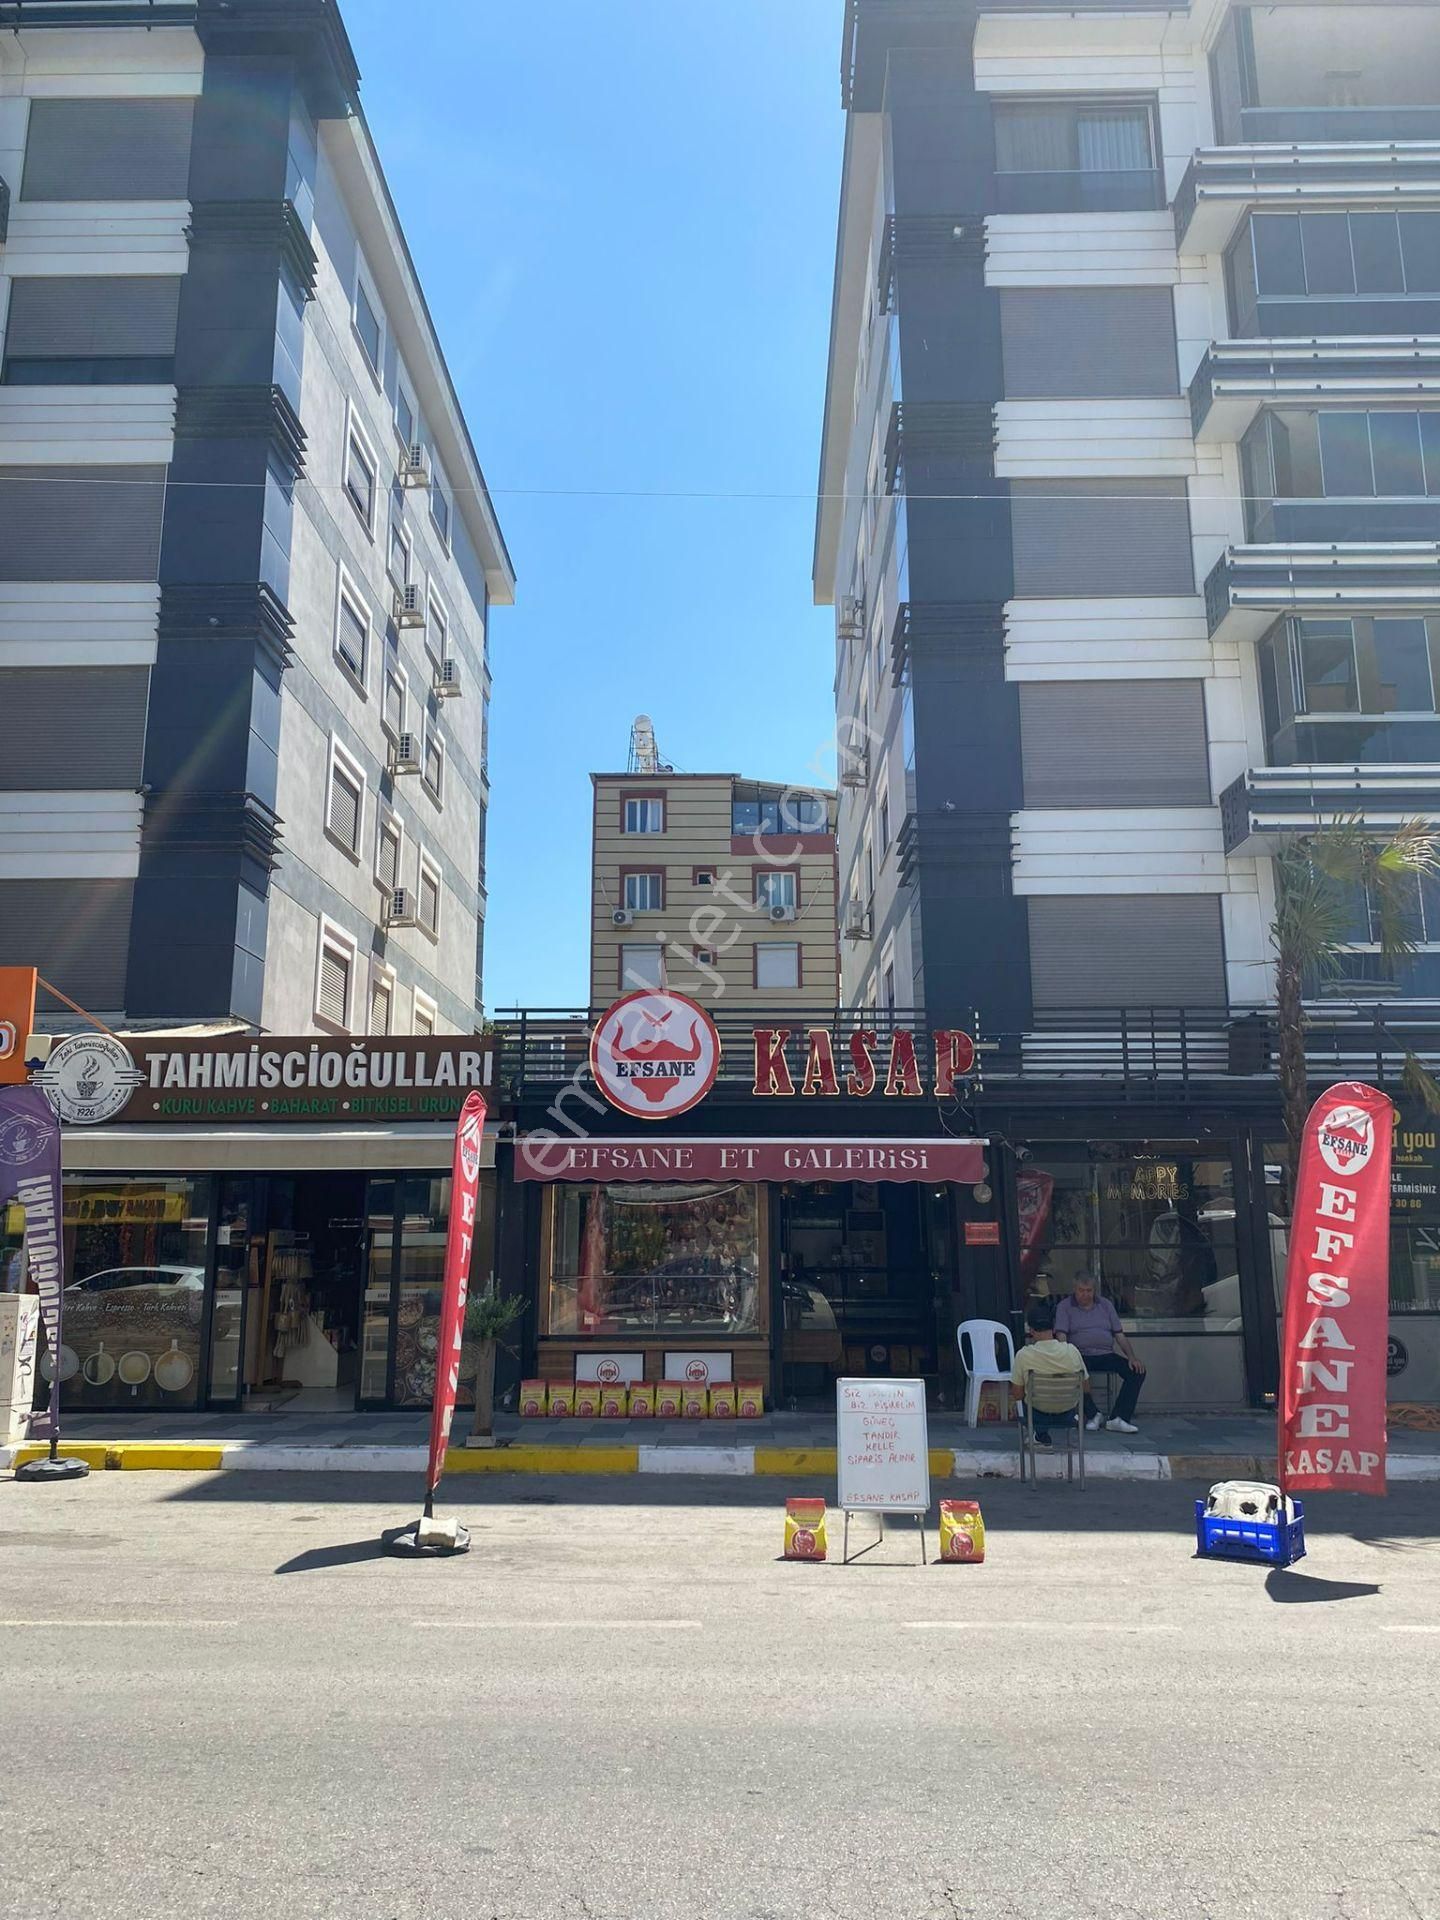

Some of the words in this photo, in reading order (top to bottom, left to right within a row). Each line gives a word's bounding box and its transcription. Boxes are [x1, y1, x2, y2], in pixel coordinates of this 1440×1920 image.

[145, 1043, 493, 1088] TAHMİSCİOĞULLARI
[615, 1061, 696, 1078] EFSANE
[752, 1029, 975, 1097] KASAP
[76, 1108, 96, 1117] 1926
[160, 1098, 202, 1115] KURU
[207, 1097, 255, 1114] KAHVE
[269, 1097, 338, 1114] BAHARAT
[351, 1096, 414, 1113] BİTKİSEL
[419, 1094, 460, 1113] ÜRÜN
[1322, 1133, 1368, 1156] EFSANE
[1403, 1132, 1436, 1153] you
[569, 1147, 694, 1170] EFSANE
[719, 1147, 760, 1169] ET
[1390, 1173, 1402, 1182] LE
[1389, 1183, 1437, 1195] ERMİSİNİZ
[1296, 1182, 1357, 1438] EFSANE
[865, 1442, 895, 1452] KELLE
[1285, 1450, 1380, 1477] KASAP
